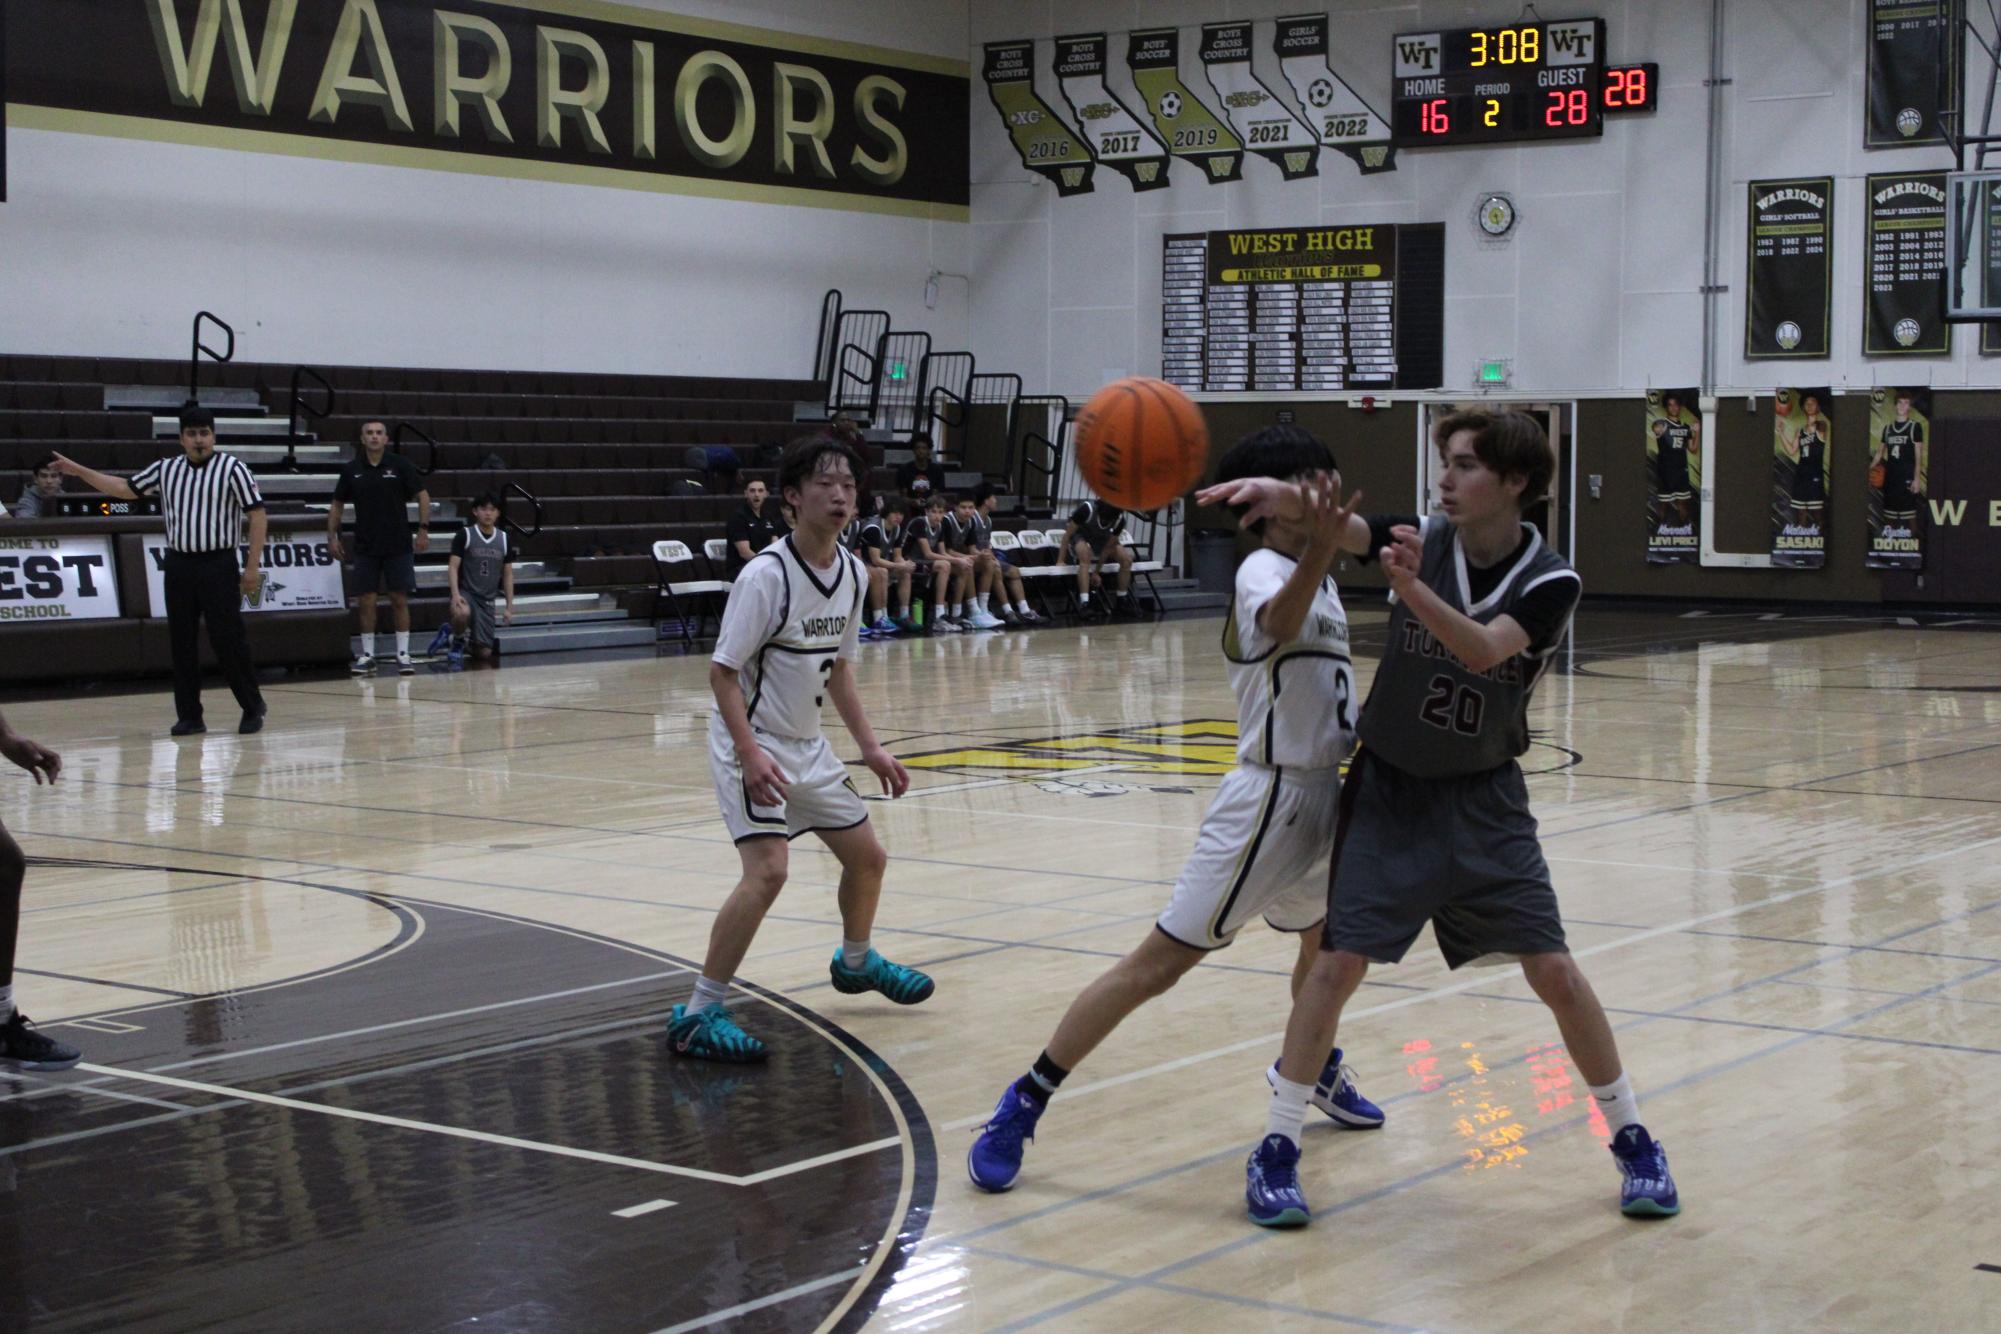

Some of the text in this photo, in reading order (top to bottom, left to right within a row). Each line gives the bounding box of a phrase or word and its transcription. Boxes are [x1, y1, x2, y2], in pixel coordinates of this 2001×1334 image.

[1212, 38, 1243, 49] CROSS
[1282, 36, 1320, 48] SOCCER
[1470, 28, 1539, 67] 3:08
[1067, 53, 1096, 63] CROSS
[1135, 49, 1171, 60] SOCCER
[1204, 47, 1249, 59] COUNTRY
[996, 59, 1024, 69] CROSS
[1059, 62, 1102, 73] COUNTRY
[988, 68, 1030, 79] COUNTRY
[1537, 67, 1586, 88] GUEST
[146, 0, 910, 186] WARRIORS
[1404, 78, 1446, 97] HOME
[1474, 82, 1511, 96] PERIOD
[1604, 69, 1647, 107] 28
[1484, 99, 1499, 127] 2
[1545, 90, 1588, 126] 28
[1421, 99, 1449, 134] 16
[1249, 125, 1289, 143] 2021
[1323, 118, 1368, 138] 2022
[1100, 136, 1140, 154] 2017
[1174, 129, 1218, 147] 2019
[1029, 141, 1069, 159] 2016
[1756, 188, 1825, 210] WARRIORS
[1874, 182, 1946, 204] WARRIORS
[1228, 228, 1374, 256] WEST HIGH
[1237, 265, 1365, 281] ATHLETIC HALL OF FAME
[1669, 428, 1688, 437] WEST
[1672, 437, 1683, 448] 15
[1887, 436, 1908, 445] WEST
[110, 502, 129, 513] POSS
[39, 538, 59, 549] TO
[1776, 536, 1824, 549] SASAKI
[1873, 538, 1920, 551] DOYON
[658, 544, 685, 557] WEST
[0, 604, 71, 619] SCHOOL
[1419, 674, 1485, 737] 20
